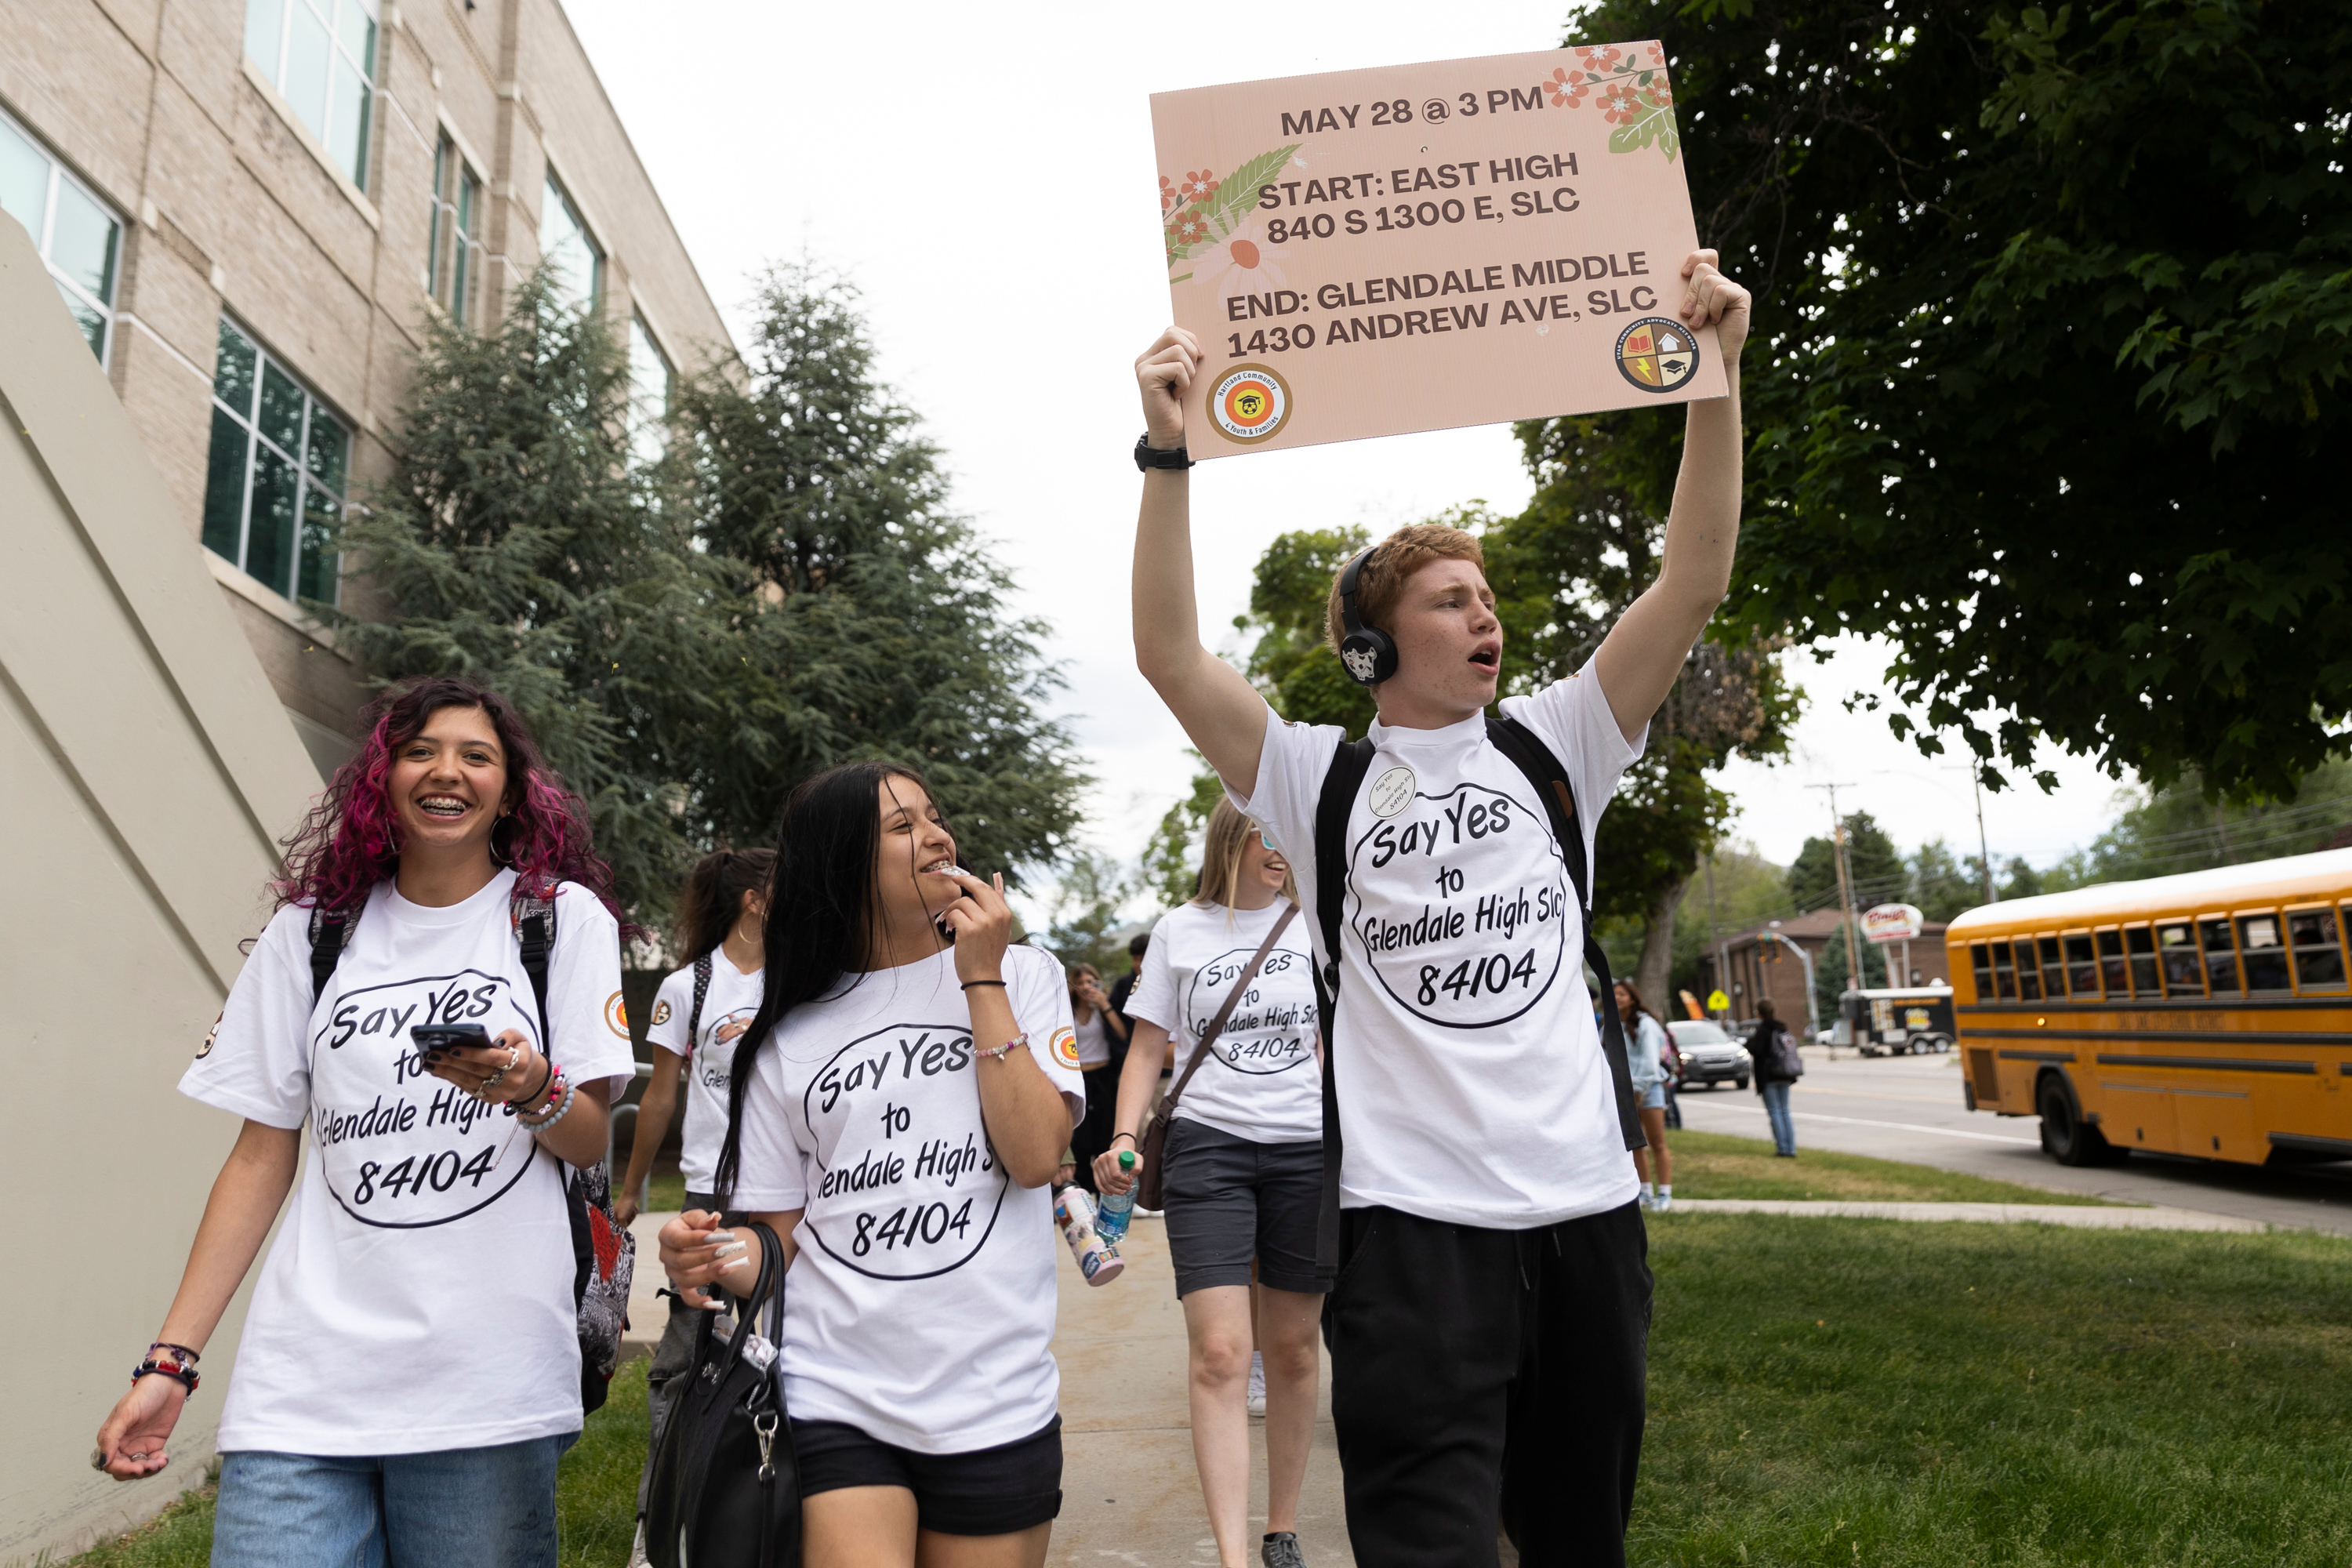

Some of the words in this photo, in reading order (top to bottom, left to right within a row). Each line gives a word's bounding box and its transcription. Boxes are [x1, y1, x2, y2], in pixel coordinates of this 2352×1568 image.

[1281, 104, 1360, 136] MAY
[1371, 100, 1413, 125] 28
[1421, 99, 1450, 124] @
[1459, 93, 1479, 116] 3
[1487, 86, 1543, 113] PM
[1258, 173, 1383, 209] START:
[1392, 162, 1479, 194] EAST
[1490, 153, 1578, 183] HIGH
[1269, 214, 1335, 243] 840
[1345, 210, 1367, 234] S
[1375, 202, 1465, 230] 1300
[1474, 196, 1503, 223] E,
[1511, 188, 1579, 216] SLC
[1227, 291, 1308, 321] END:
[1317, 266, 1504, 309] GLENDALE
[1512, 252, 1649, 287] MIDDLE
[1228, 324, 1315, 358] 1430
[1327, 303, 1488, 345] ANDREW
[1501, 295, 1580, 325] AVE,
[1588, 286, 1657, 315] SLC
[1620, 320, 1645, 343] COMMUNITY
[1646, 318, 1678, 328] ADVOCATE
[1678, 327, 1697, 350] NETWORK
[1218, 374, 1241, 397] Hartland
[1243, 372, 1277, 390] Community
[1230, 424, 1247, 435] Youth
[1254, 416, 1279, 434] Families
[1389, 789, 1407, 810] 84104
[1372, 820, 1439, 868] Say
[1445, 792, 1510, 844] Yes
[1436, 866, 1464, 898] to
[1364, 905, 1464, 952] Glendale
[1475, 887, 1529, 939] High
[1537, 887, 1563, 921] Slc
[1243, 989, 1259, 1007] to
[1418, 949, 1536, 1006] 84104
[331, 1004, 417, 1049] Say
[425, 981, 497, 1025] Yes
[1264, 1003, 1298, 1032] High
[393, 1048, 423, 1084] to
[819, 1051, 891, 1113] Say
[899, 1033, 973, 1079] Yes
[1229, 1037, 1301, 1062] 84104
[321, 1094, 417, 1147] Glendale
[881, 1102, 910, 1139] to
[354, 1145, 496, 1205] 84104
[914, 1133, 977, 1187] High
[852, 1197, 973, 1257] 84104
